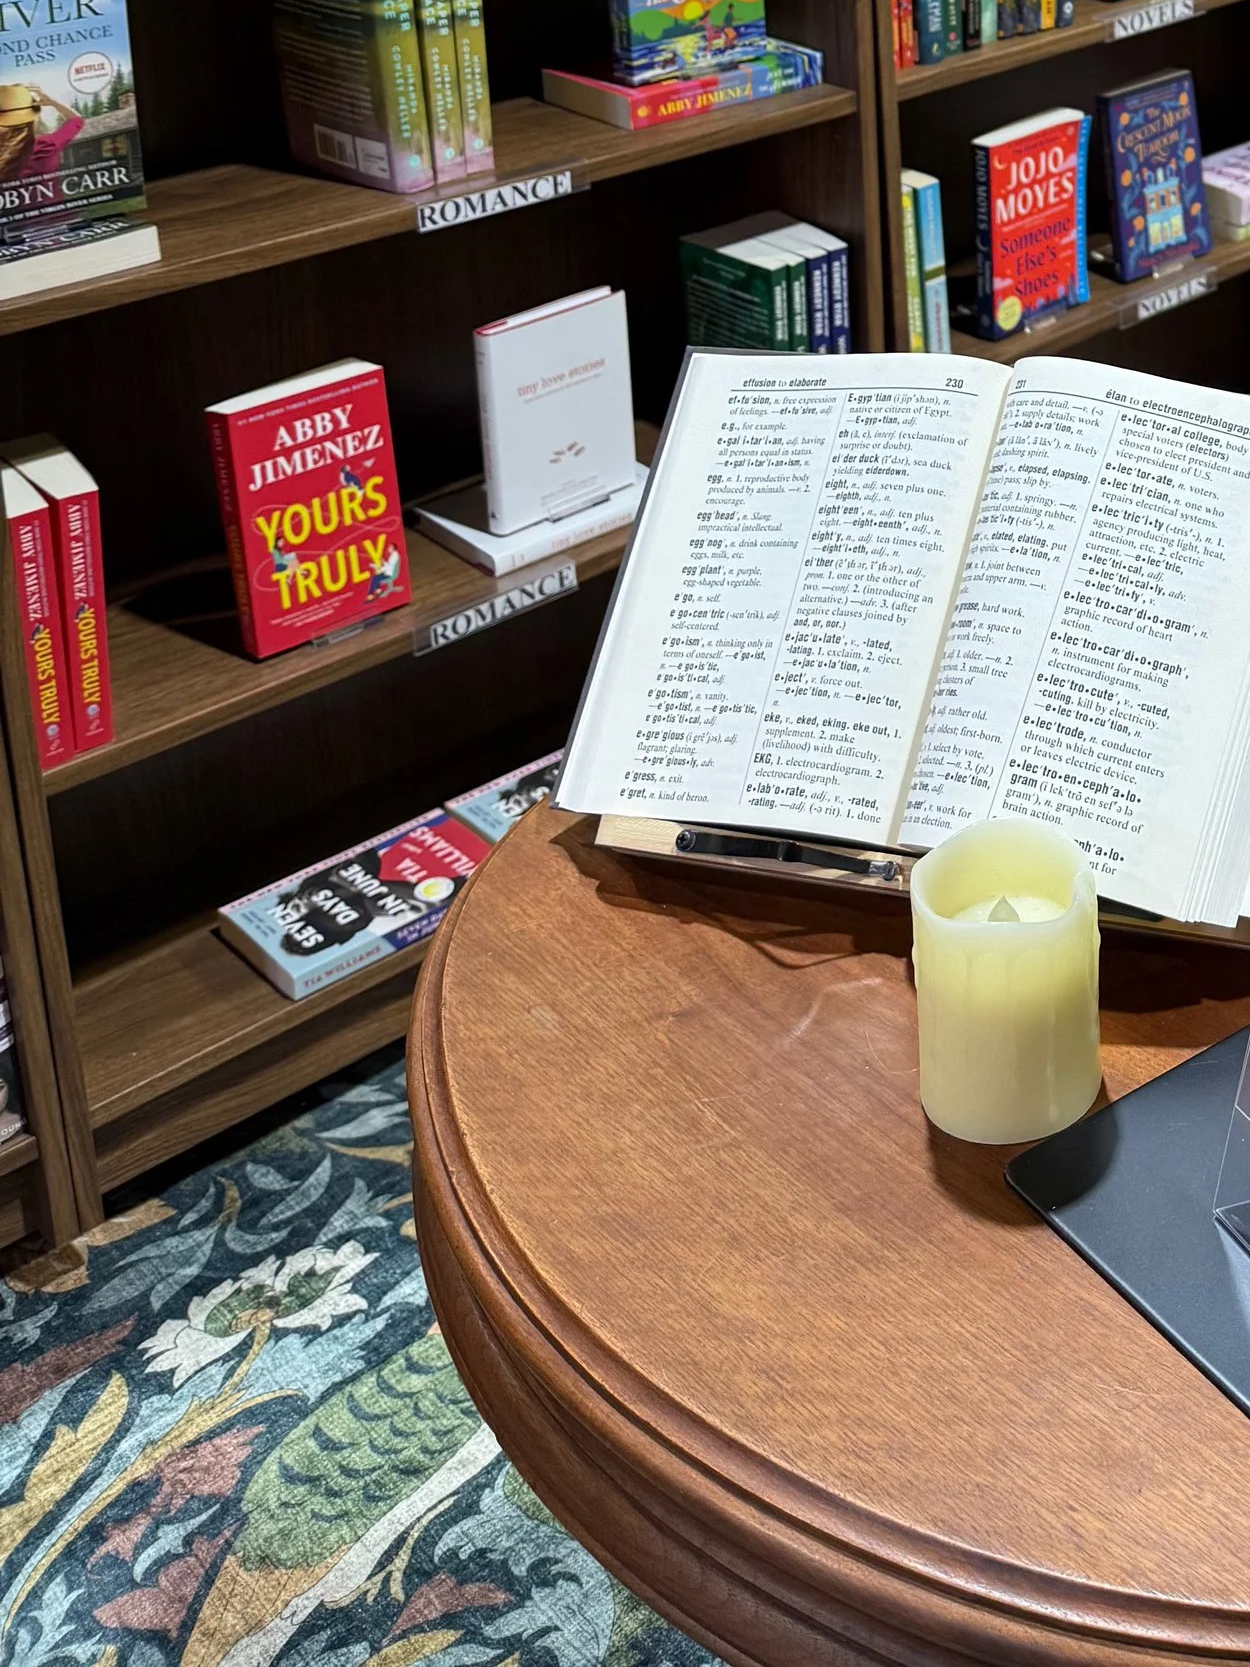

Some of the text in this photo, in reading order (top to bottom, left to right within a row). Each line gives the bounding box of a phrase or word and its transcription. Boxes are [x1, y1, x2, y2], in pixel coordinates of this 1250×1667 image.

[35, 25, 114, 54] CHANCE
[14, 51, 56, 68] PASS
[62, 166, 130, 196] CARR
[1007, 146, 1065, 190] JOJO
[418, 172, 572, 230] ROMANCE
[995, 172, 1074, 224] MOYES
[1000, 217, 1071, 259] Someone
[1015, 245, 1057, 276] Else's
[541, 371, 566, 389] love
[742, 378, 827, 387] effusion to elaborate
[945, 378, 964, 389] 230
[1106, 389, 1127, 403] élan
[1130, 397, 1140, 406] to
[273, 403, 354, 451] ABBY
[1123, 426, 1229, 462] special voters (electors)
[248, 424, 385, 492] JIMENEZ
[255, 475, 388, 554] YOURS
[271, 533, 387, 610] TRULY
[430, 564, 574, 648] ROMANCE
[1047, 657, 1142, 692] electrocardiograms.
[395, 857, 428, 884] TIA
[311, 888, 360, 925] DAYS
[339, 863, 411, 918] IN JUNE
[265, 902, 325, 949] SEVEN
